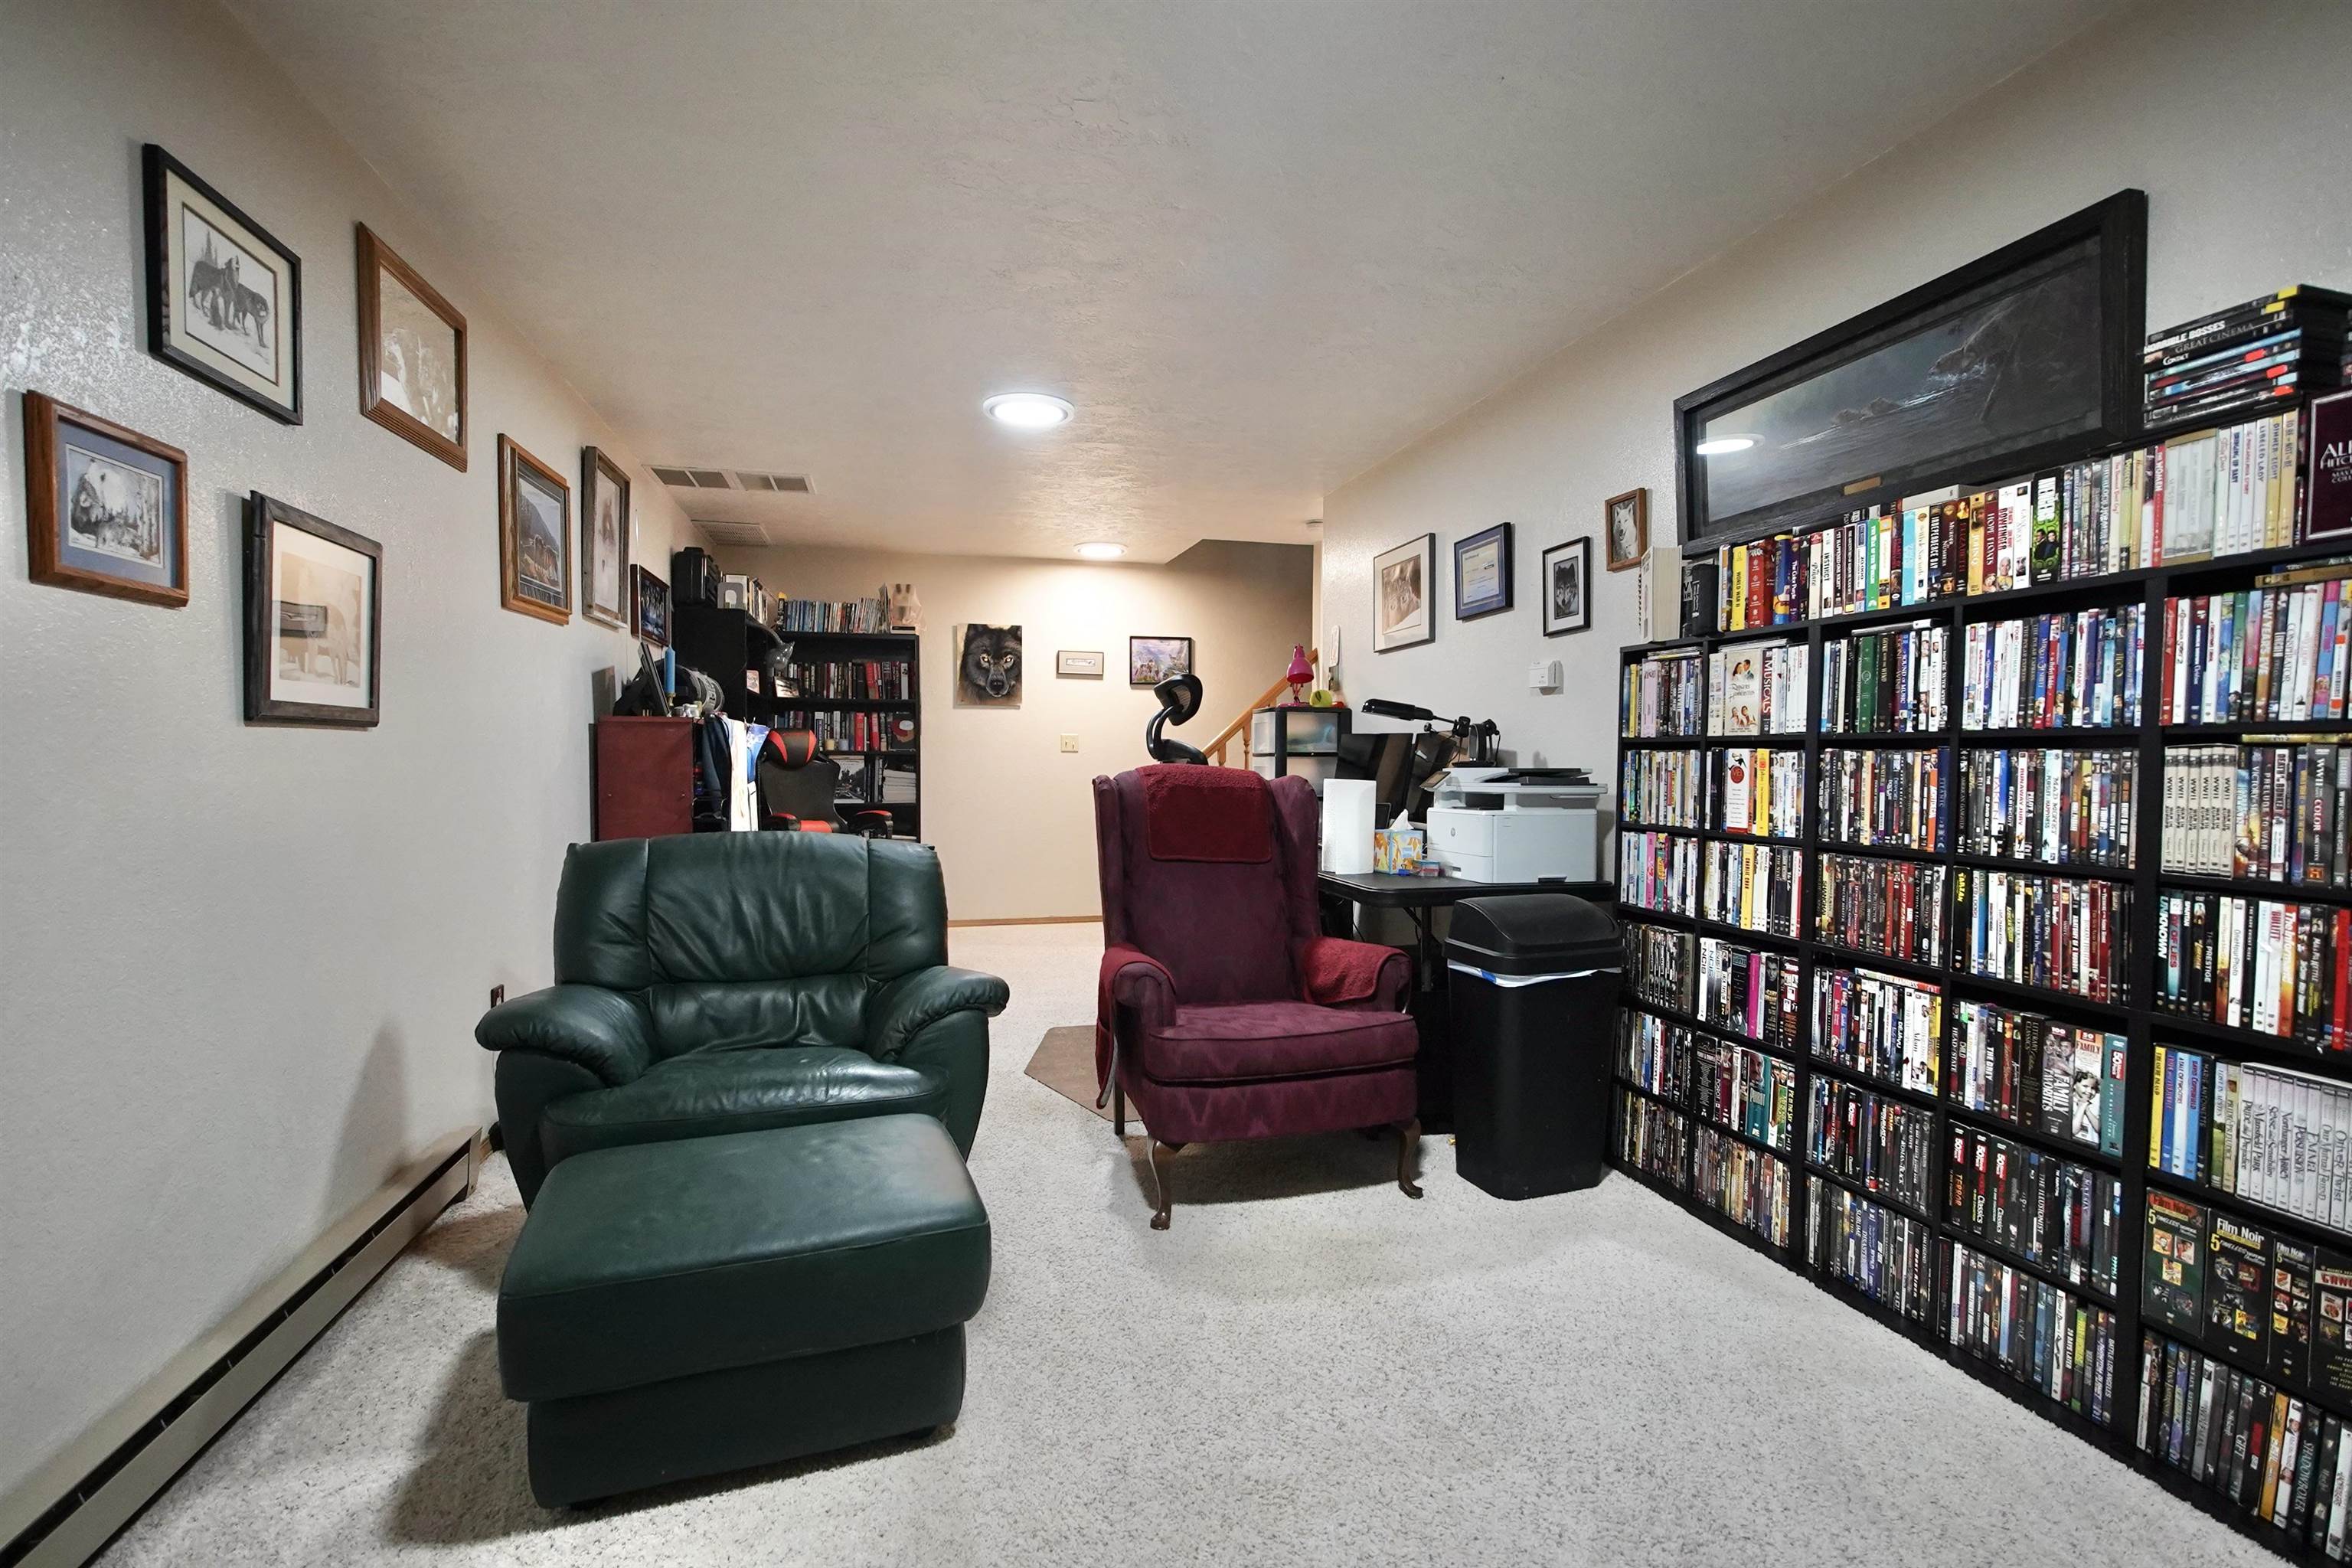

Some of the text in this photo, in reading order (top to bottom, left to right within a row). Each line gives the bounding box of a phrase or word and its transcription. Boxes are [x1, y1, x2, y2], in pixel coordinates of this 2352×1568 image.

[2262, 594, 2274, 620] NEW
[2259, 657, 2270, 675] EVE
[1762, 660, 1773, 714] MUSICALS
[2314, 758, 2325, 786] WWII
[2313, 799, 2323, 831] COLOR
[2158, 896, 2168, 959] UNKNOWN
[2203, 946, 2213, 983] PRESTIGE
[2042, 1068, 2053, 1112] FAVORITES
[2052, 1075, 2069, 1116] FAMILY
[2217, 1218, 2238, 1235] Film
[2295, 1440, 2314, 1514] SHADOWBOXER
